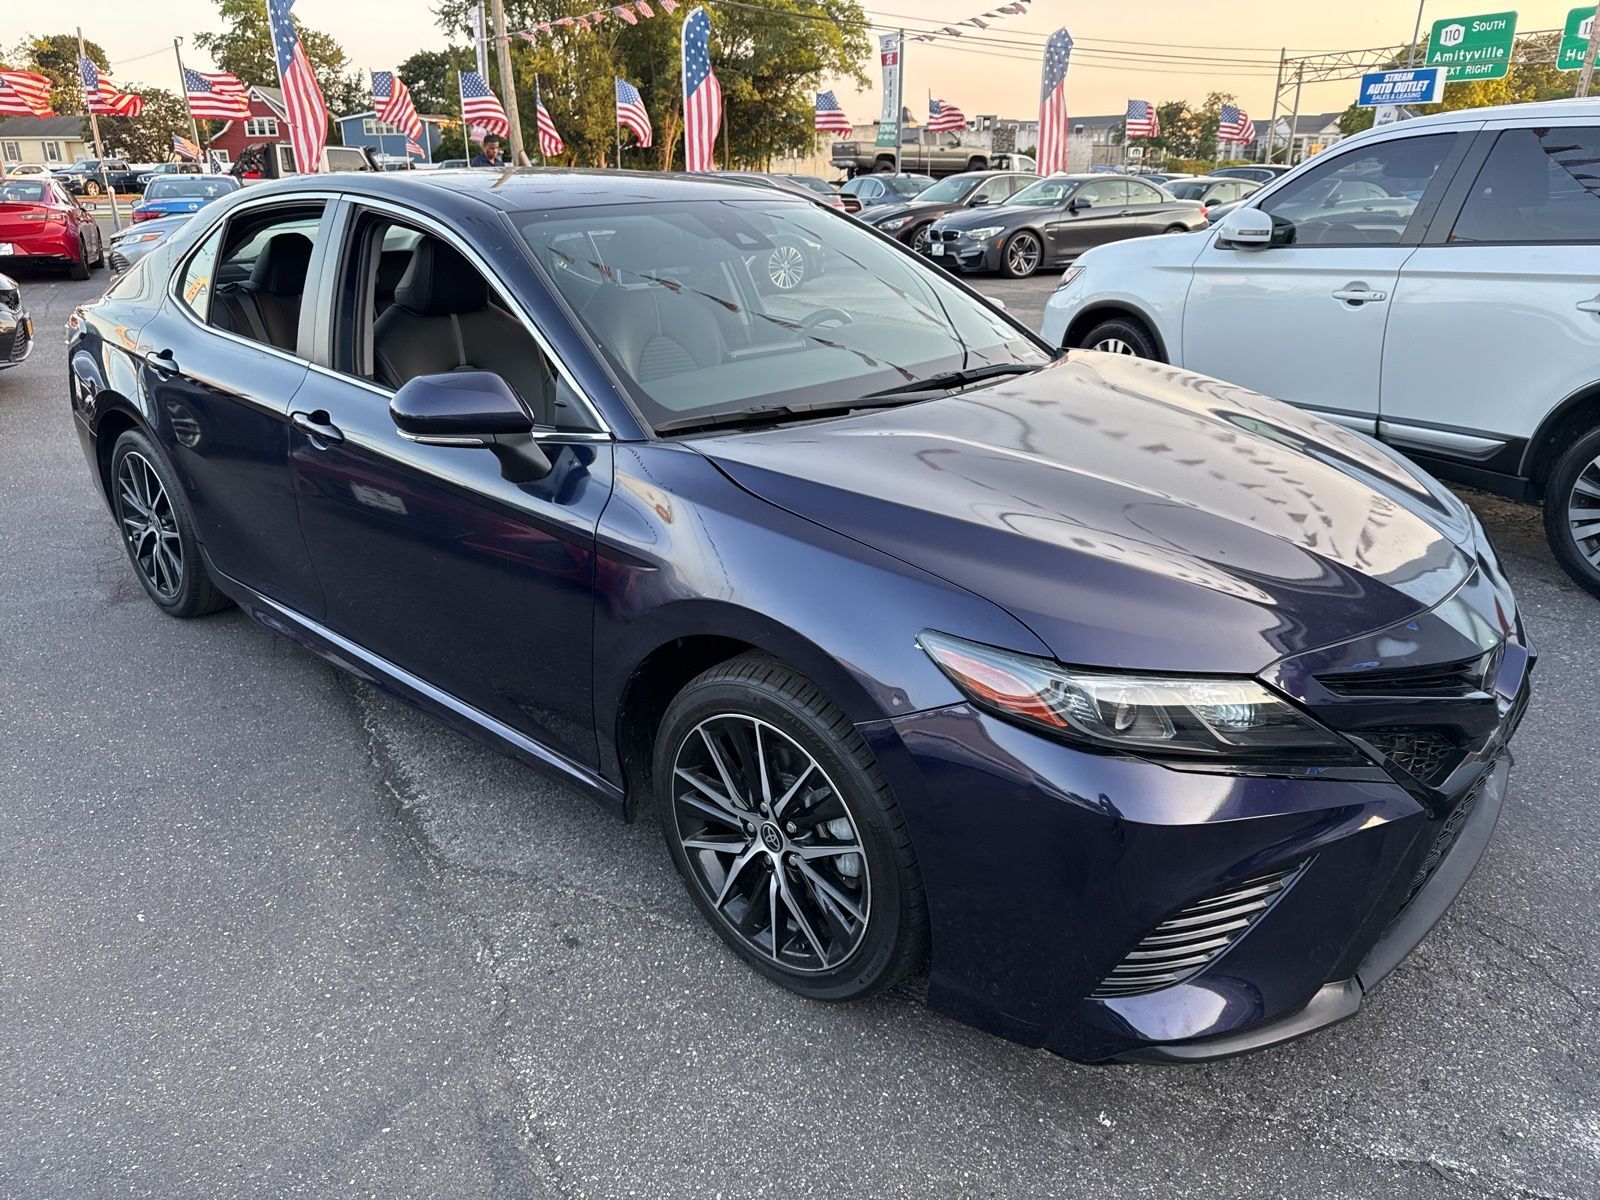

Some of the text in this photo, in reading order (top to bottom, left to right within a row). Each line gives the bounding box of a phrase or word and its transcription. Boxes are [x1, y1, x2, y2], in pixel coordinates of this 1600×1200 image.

[1583, 22, 1594, 34] 11
[1444, 28, 1461, 43] 110
[1432, 47, 1504, 63] Amityville
[1466, 64, 1493, 74] RIGHT
[1384, 72, 1415, 82] STREAM
[1366, 80, 1430, 95] AUTO OUTLET
